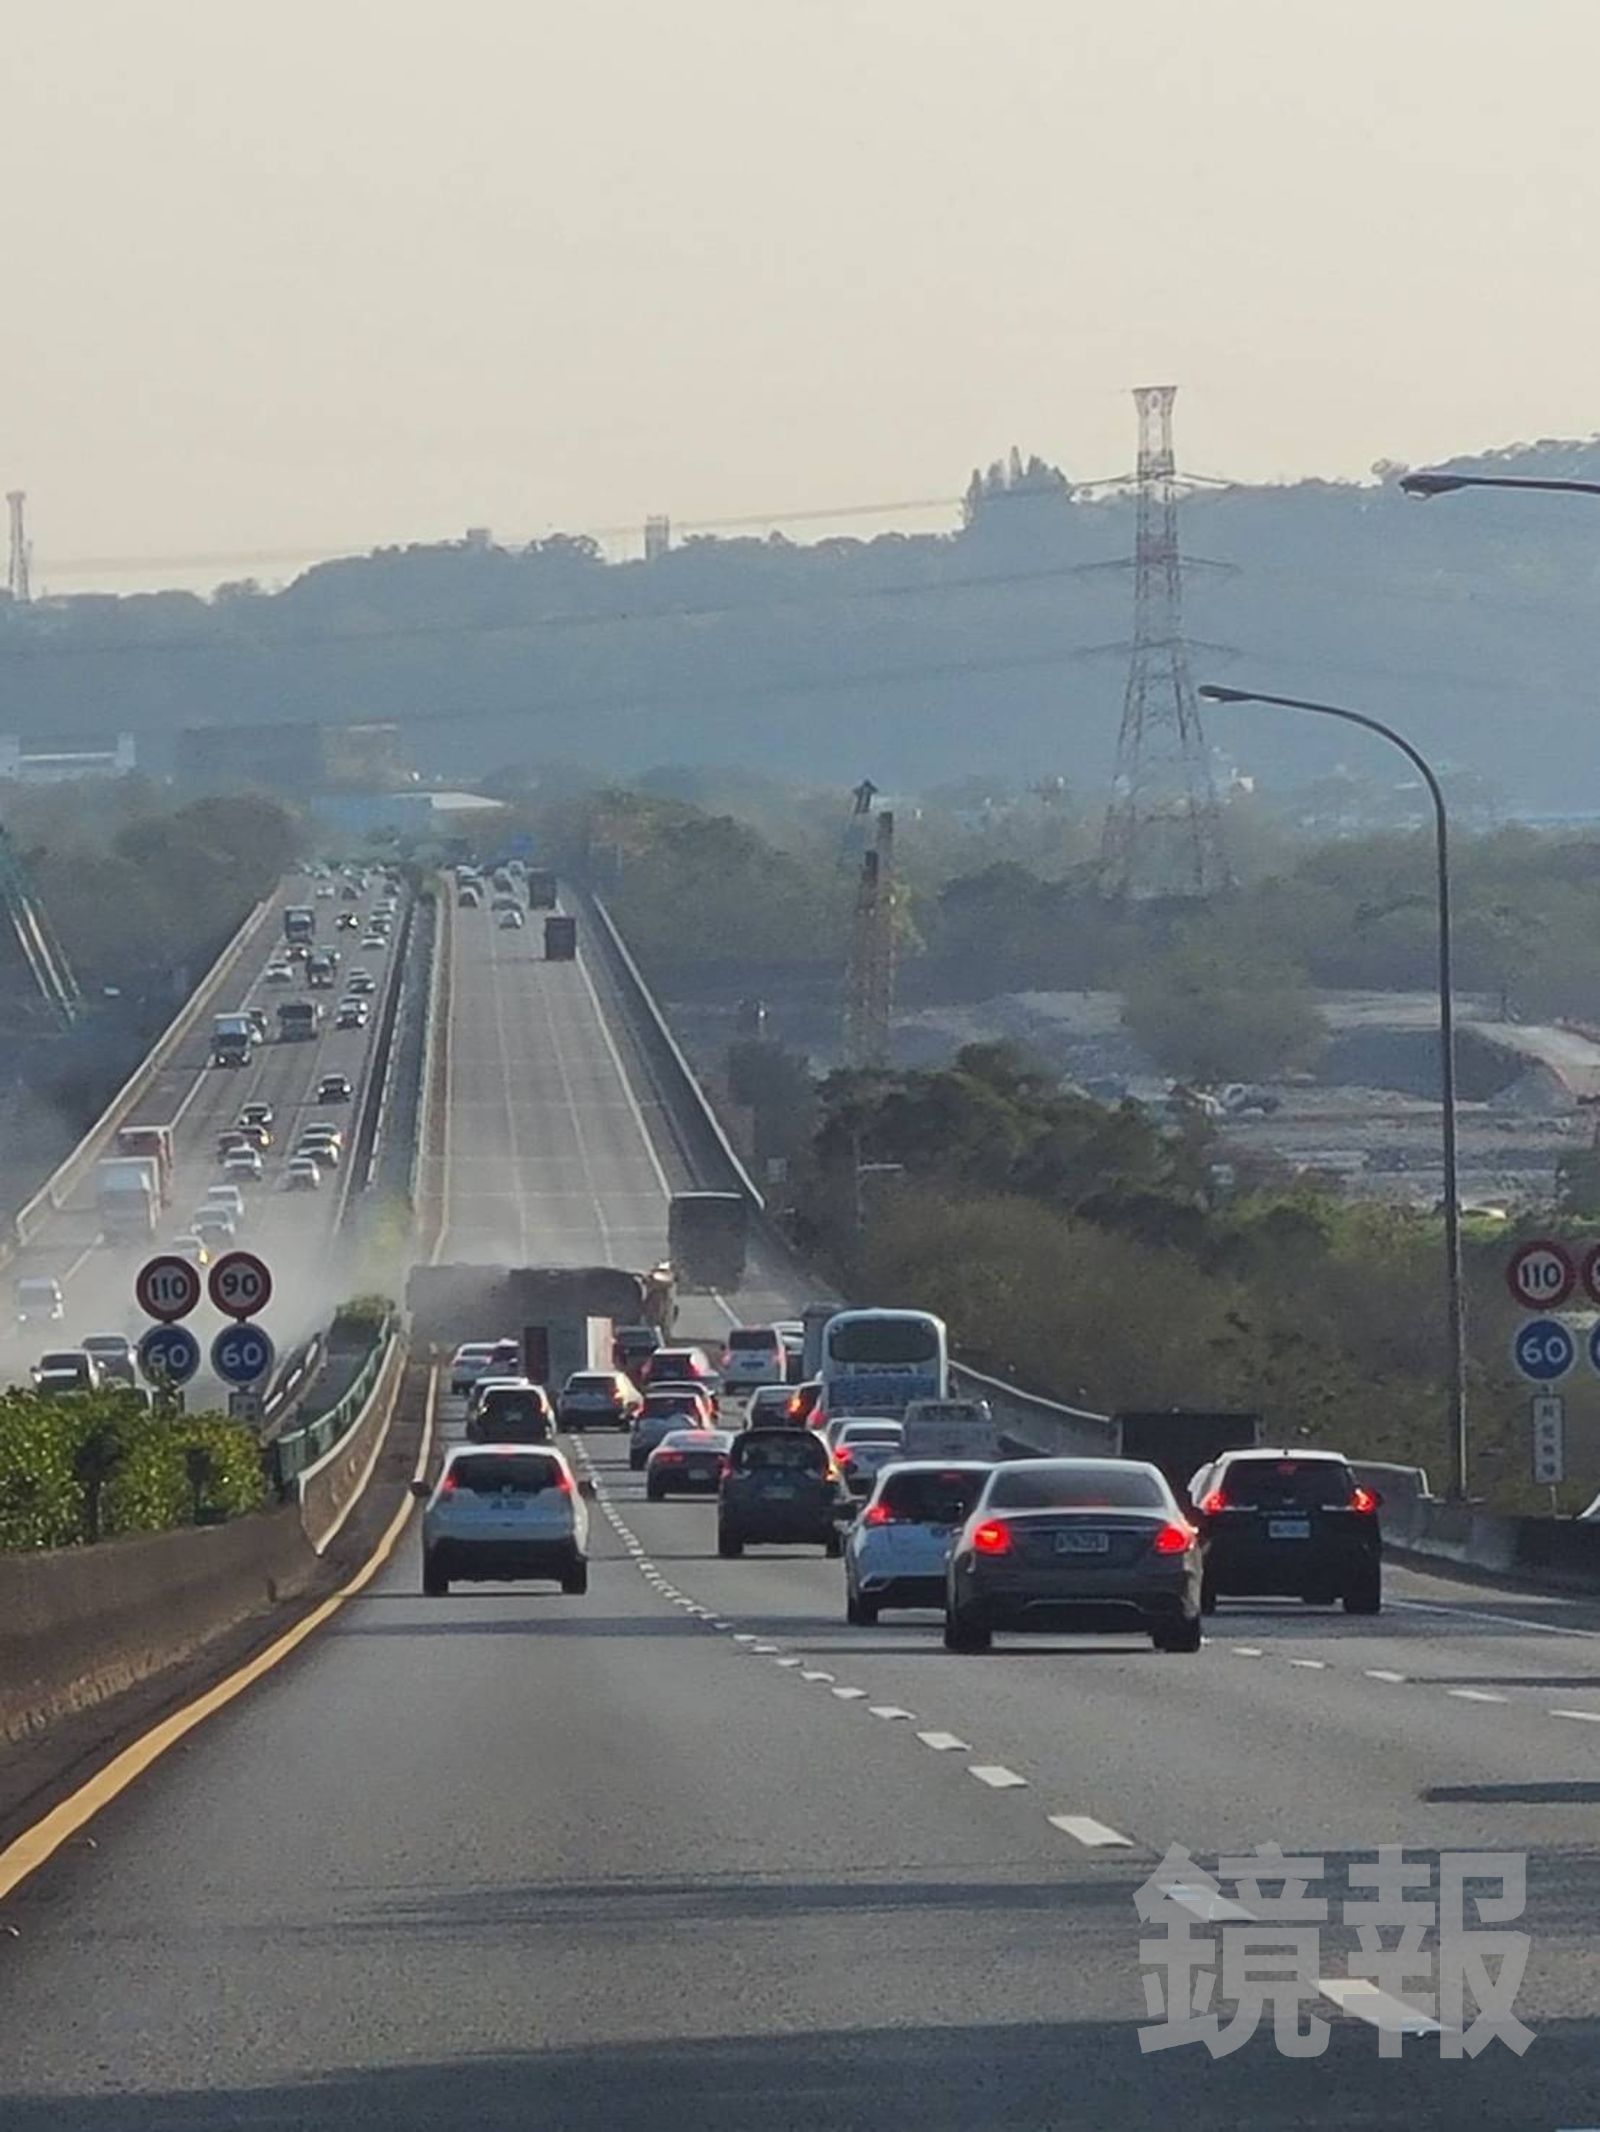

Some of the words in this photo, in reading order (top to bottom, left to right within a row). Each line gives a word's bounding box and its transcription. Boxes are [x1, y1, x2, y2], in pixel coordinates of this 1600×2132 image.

[222, 1273, 258, 1297] 90
[1522, 1262, 1561, 1288] 110
[151, 1276, 188, 1300] 110
[149, 1344, 190, 1368] 60
[222, 1342, 263, 1367] 60
[1522, 1336, 1567, 1364] 60
